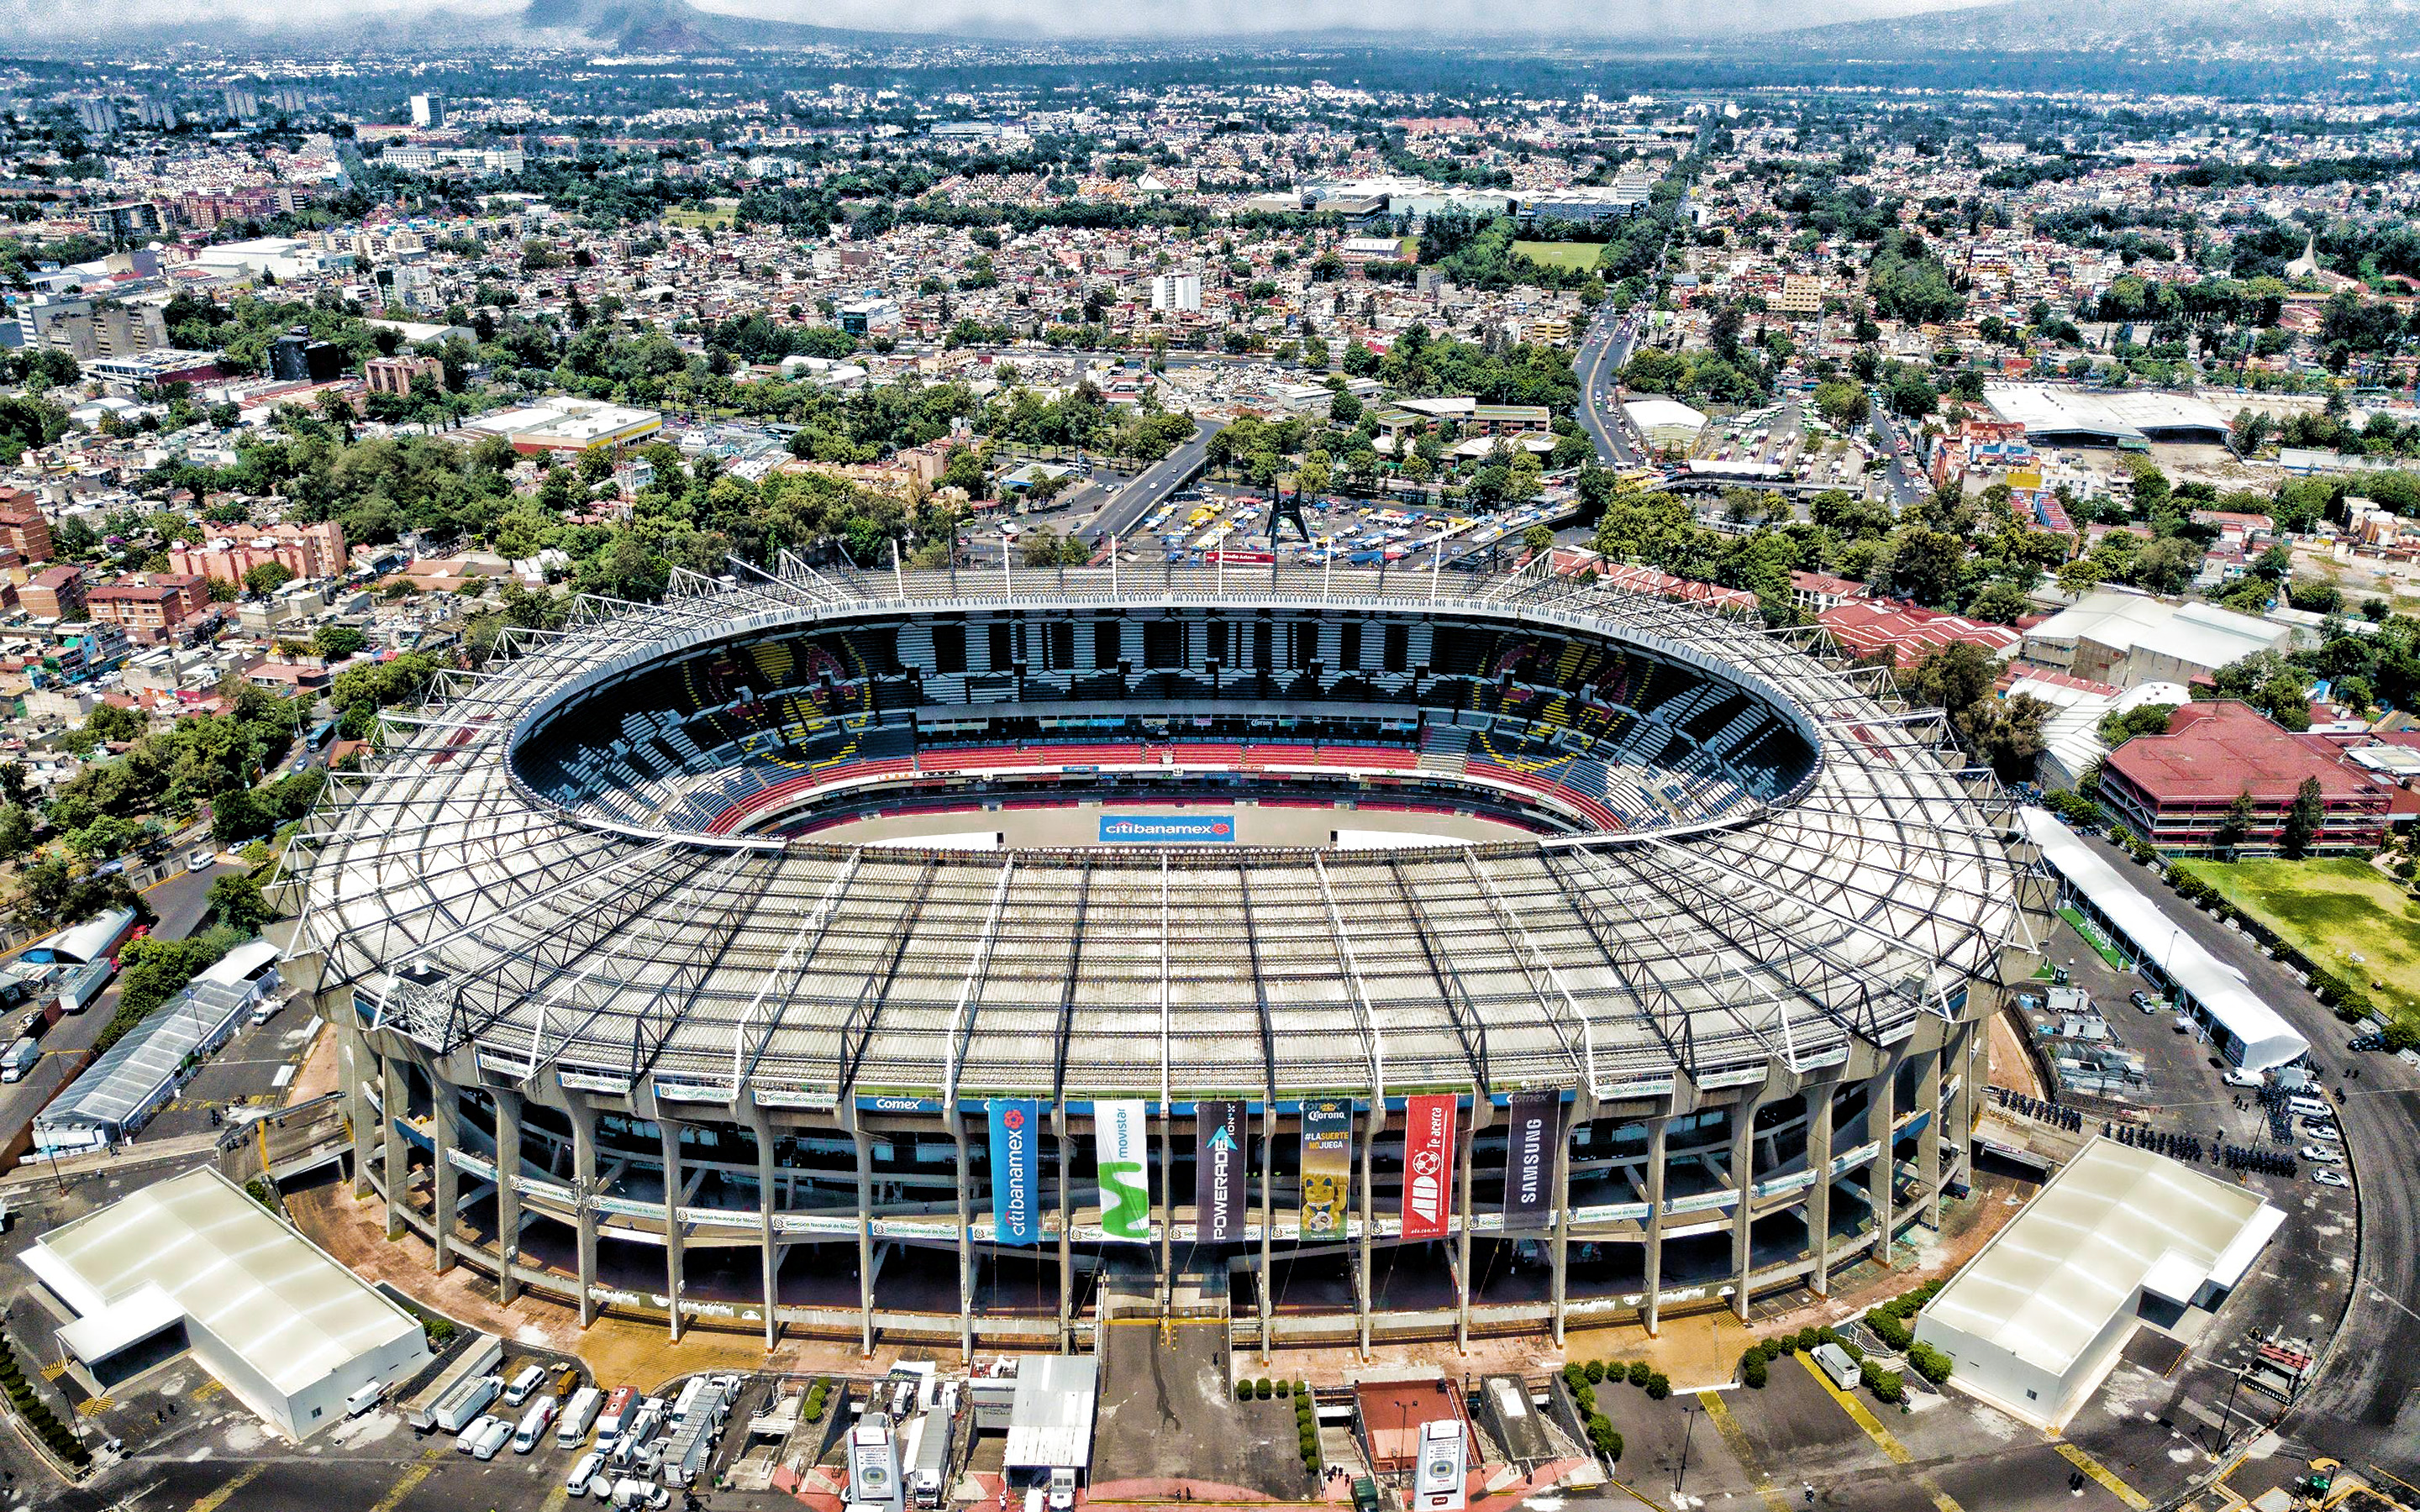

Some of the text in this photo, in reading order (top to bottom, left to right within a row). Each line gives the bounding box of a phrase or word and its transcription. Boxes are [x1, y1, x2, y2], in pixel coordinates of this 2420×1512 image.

[1106, 822, 1212, 834] citibanamex
[876, 1099, 922, 1110] Comex
[1308, 1110, 1346, 1121] Corona
[1118, 1108, 1128, 1158] movistar
[1304, 1131, 1349, 1141] #LASUERTE
[1427, 1107, 1442, 1148] Te acerca
[1308, 1141, 1343, 1149] NOJUEGA
[1521, 1118, 1542, 1204] SAMSUNG
[1008, 1130, 1025, 1236] citibanamex
[1213, 1137, 1228, 1240] POWERADE
